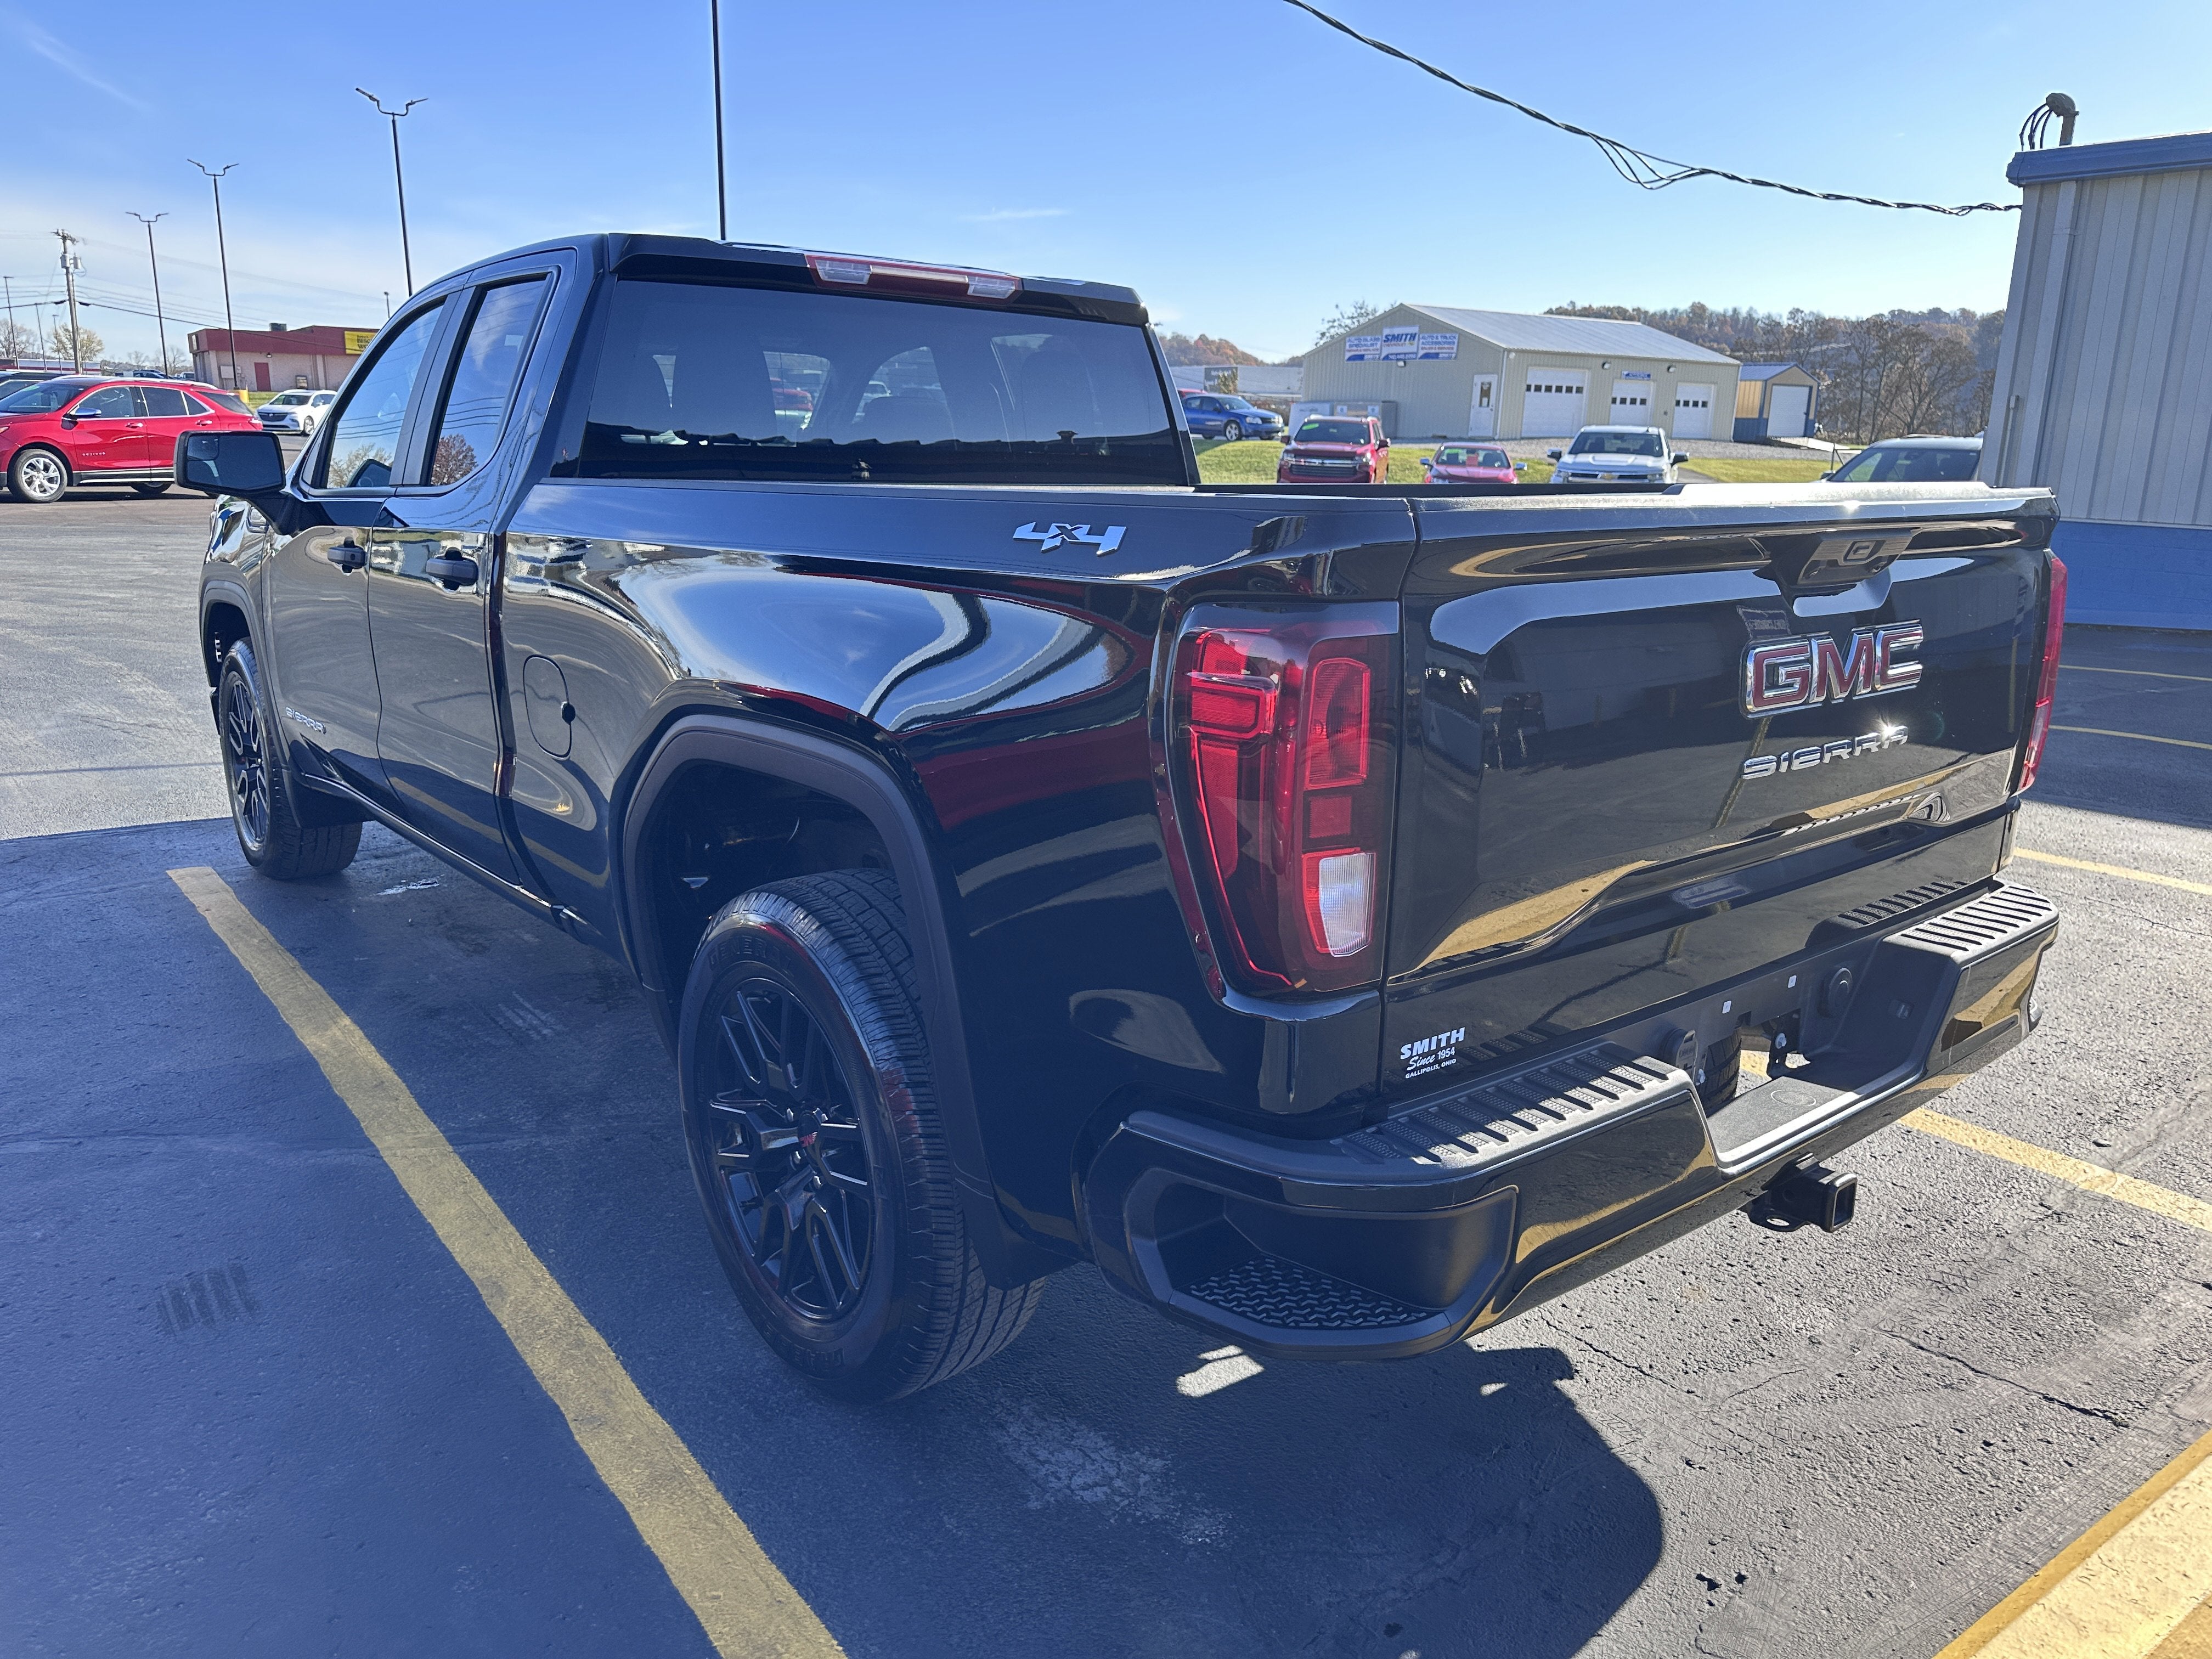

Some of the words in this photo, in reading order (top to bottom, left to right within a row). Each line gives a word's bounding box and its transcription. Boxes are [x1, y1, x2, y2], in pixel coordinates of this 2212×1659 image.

[1384, 333, 1418, 343] SMITH
[1745, 623, 1924, 713] GMC
[286, 707, 327, 734] SIERRA
[1741, 725, 1909, 780] SIERRA
[1400, 1027, 1465, 1060] SMITH
[1407, 1053, 1435, 1071] Since
[1437, 1046, 1456, 1060] 1954
[1441, 1058, 1457, 1068] OHIO
